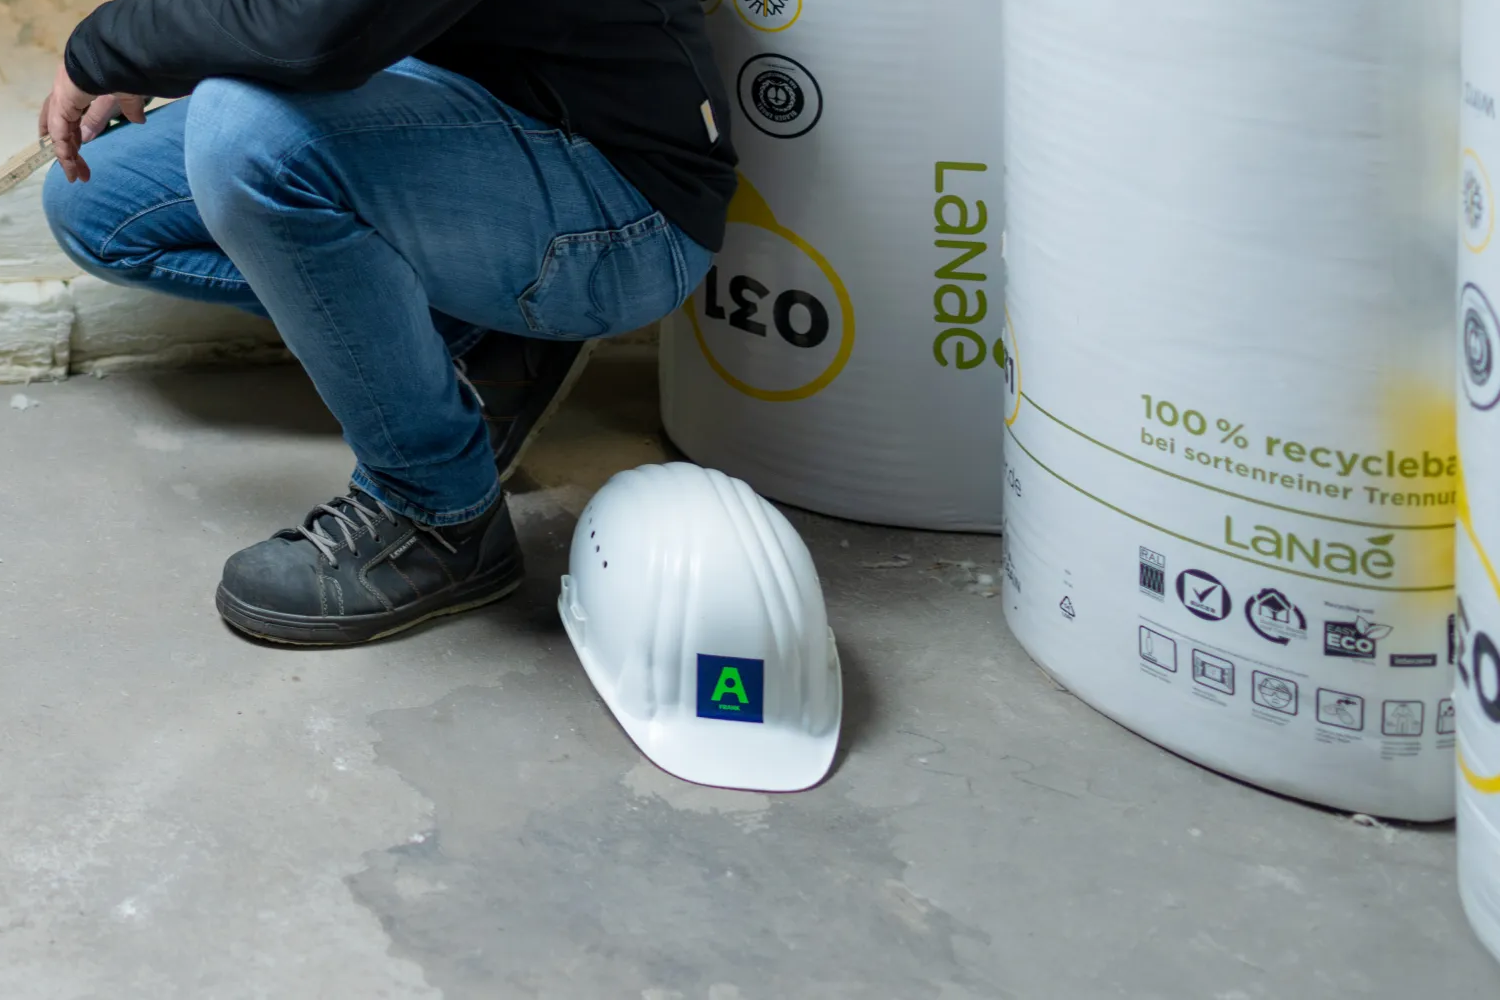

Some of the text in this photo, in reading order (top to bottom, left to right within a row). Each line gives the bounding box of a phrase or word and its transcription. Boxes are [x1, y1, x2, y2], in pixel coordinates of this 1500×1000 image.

[705, 265, 829, 348] 031
[1141, 394, 1207, 436] 100
[1216, 418, 1249, 449] %
[1141, 427, 1175, 454] bei
[1185, 444, 1352, 500] sortenreiner
[1140, 550, 1165, 567] RAL
[1326, 624, 1357, 636] EASY
[1326, 633, 1374, 653] ECO
[711, 667, 749, 704] A
